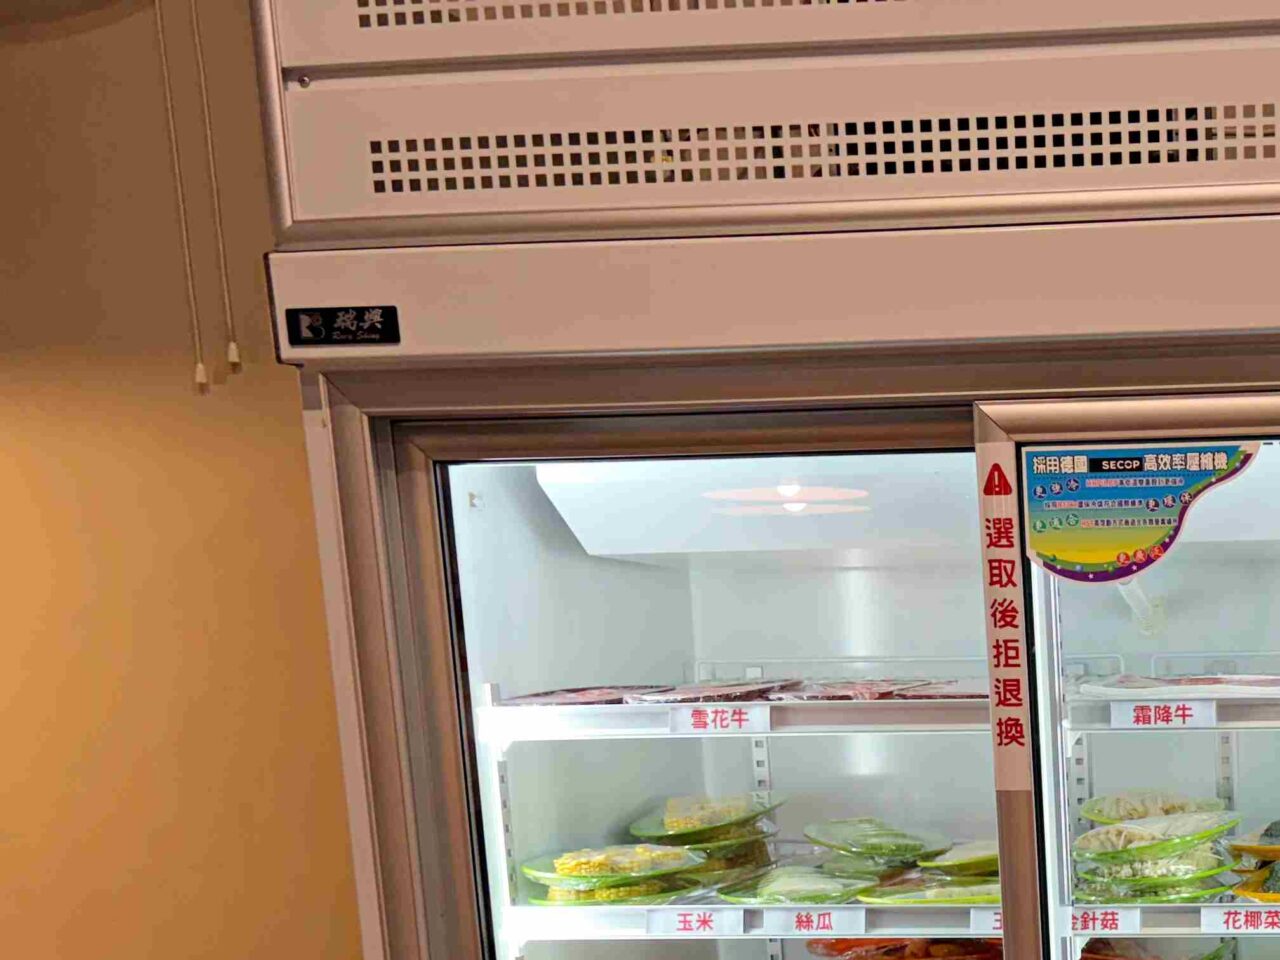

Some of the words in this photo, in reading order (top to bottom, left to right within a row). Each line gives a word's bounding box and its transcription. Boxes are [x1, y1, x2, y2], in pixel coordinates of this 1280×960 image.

[1101, 460, 1141, 470] SECOP
[985, 517, 1026, 749] 選取後拒退換
[691, 708, 750, 730] 雪花牛
[1132, 703, 1194, 726] 霜降牛
[676, 912, 714, 932] 玉米
[795, 912, 833, 932] 絲瓜
